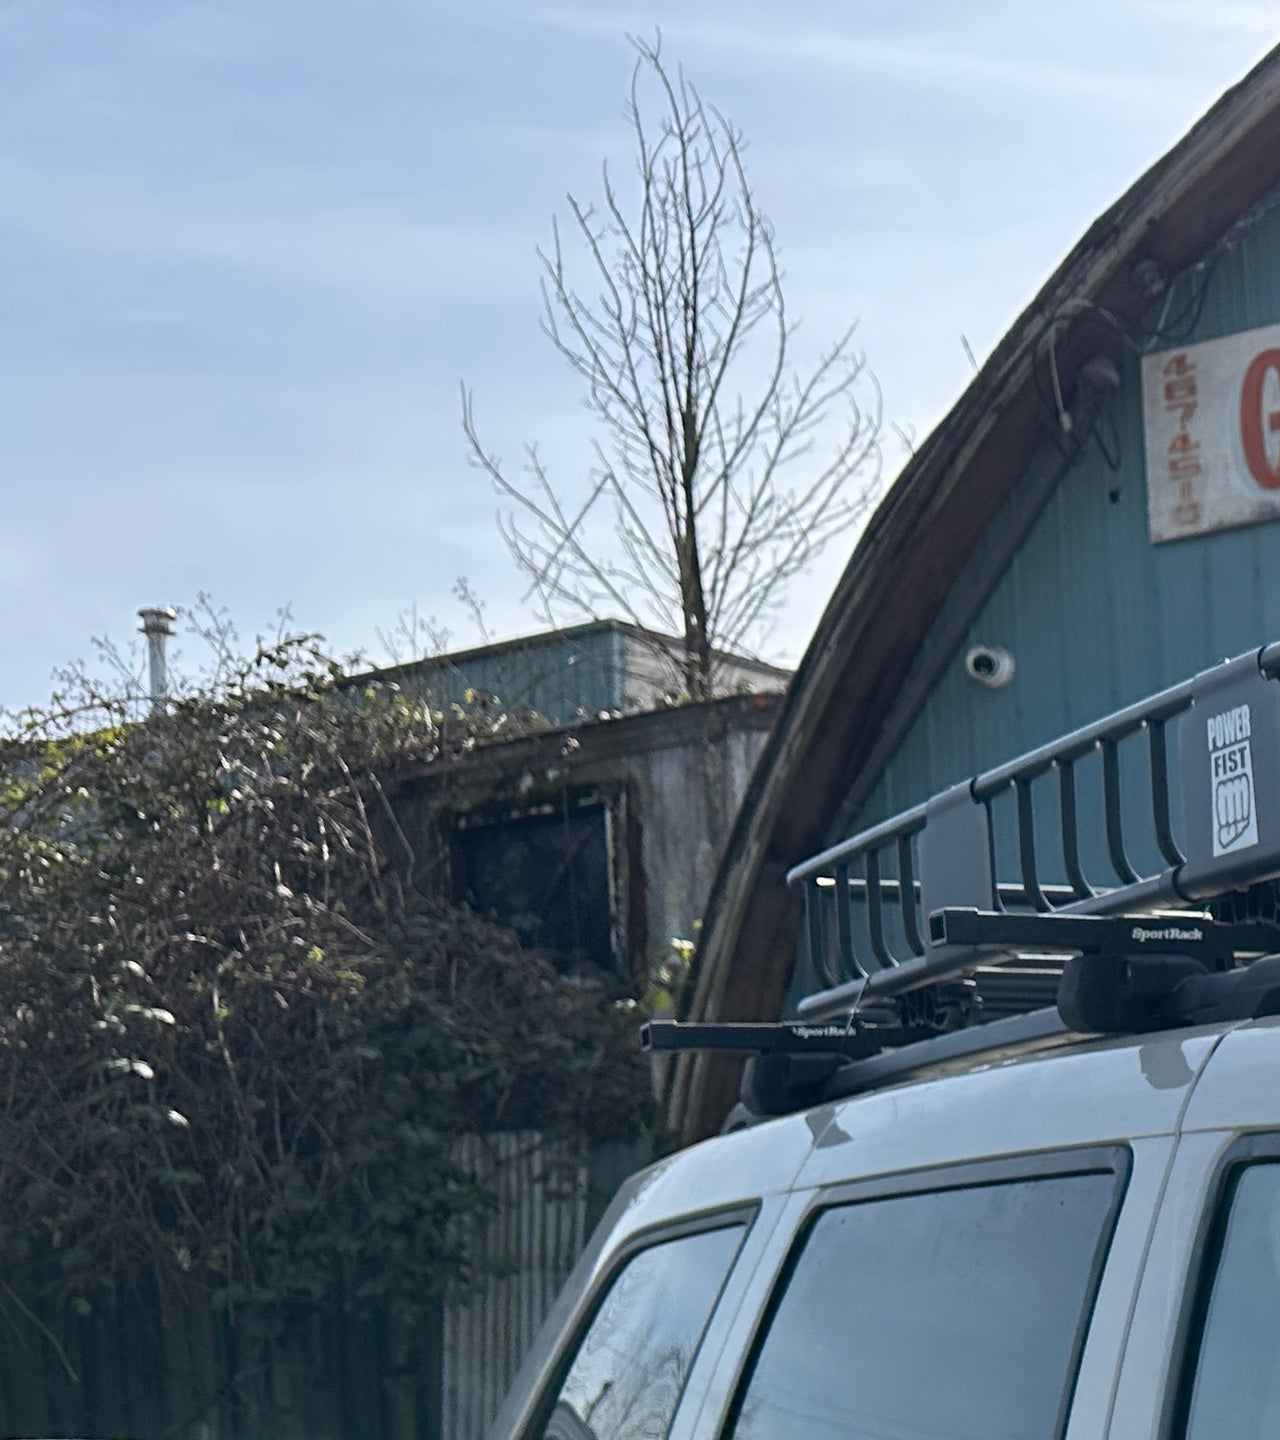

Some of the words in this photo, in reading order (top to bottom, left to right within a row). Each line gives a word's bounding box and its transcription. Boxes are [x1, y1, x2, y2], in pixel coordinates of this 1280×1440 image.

[1207, 703, 1251, 752] POWER
[1214, 746, 1247, 778] FIST
[1132, 926, 1203, 943] SportRack
